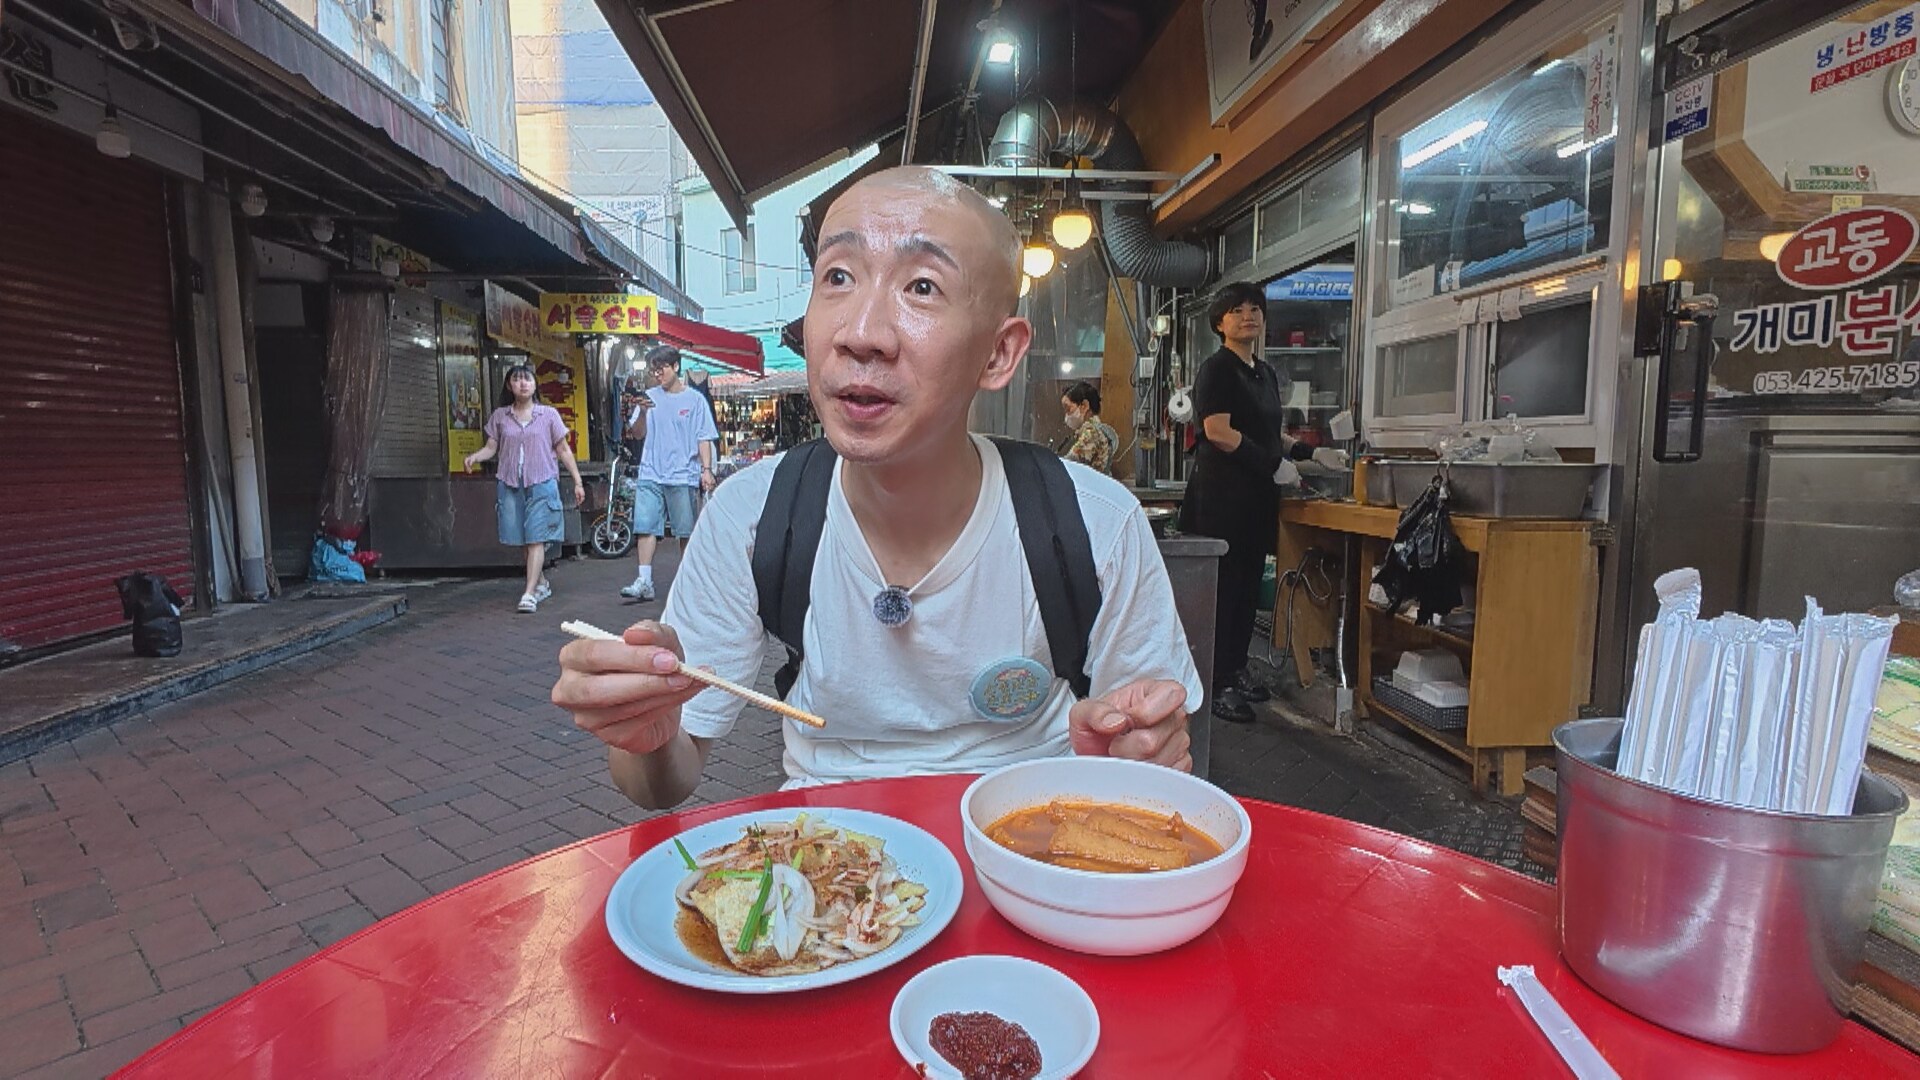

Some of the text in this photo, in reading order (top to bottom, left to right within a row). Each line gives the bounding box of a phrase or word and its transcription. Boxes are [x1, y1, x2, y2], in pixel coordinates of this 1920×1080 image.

[1587, 48, 1604, 136] 정기휴일
[1674, 80, 1704, 103] CCTV
[1794, 215, 1891, 275] 교동
[1289, 281, 1353, 296] MAGICE
[547, 303, 652, 331] 서울순대
[1730, 284, 1920, 355] 개미분
[1753, 361, 1920, 395] 053.425.7185
